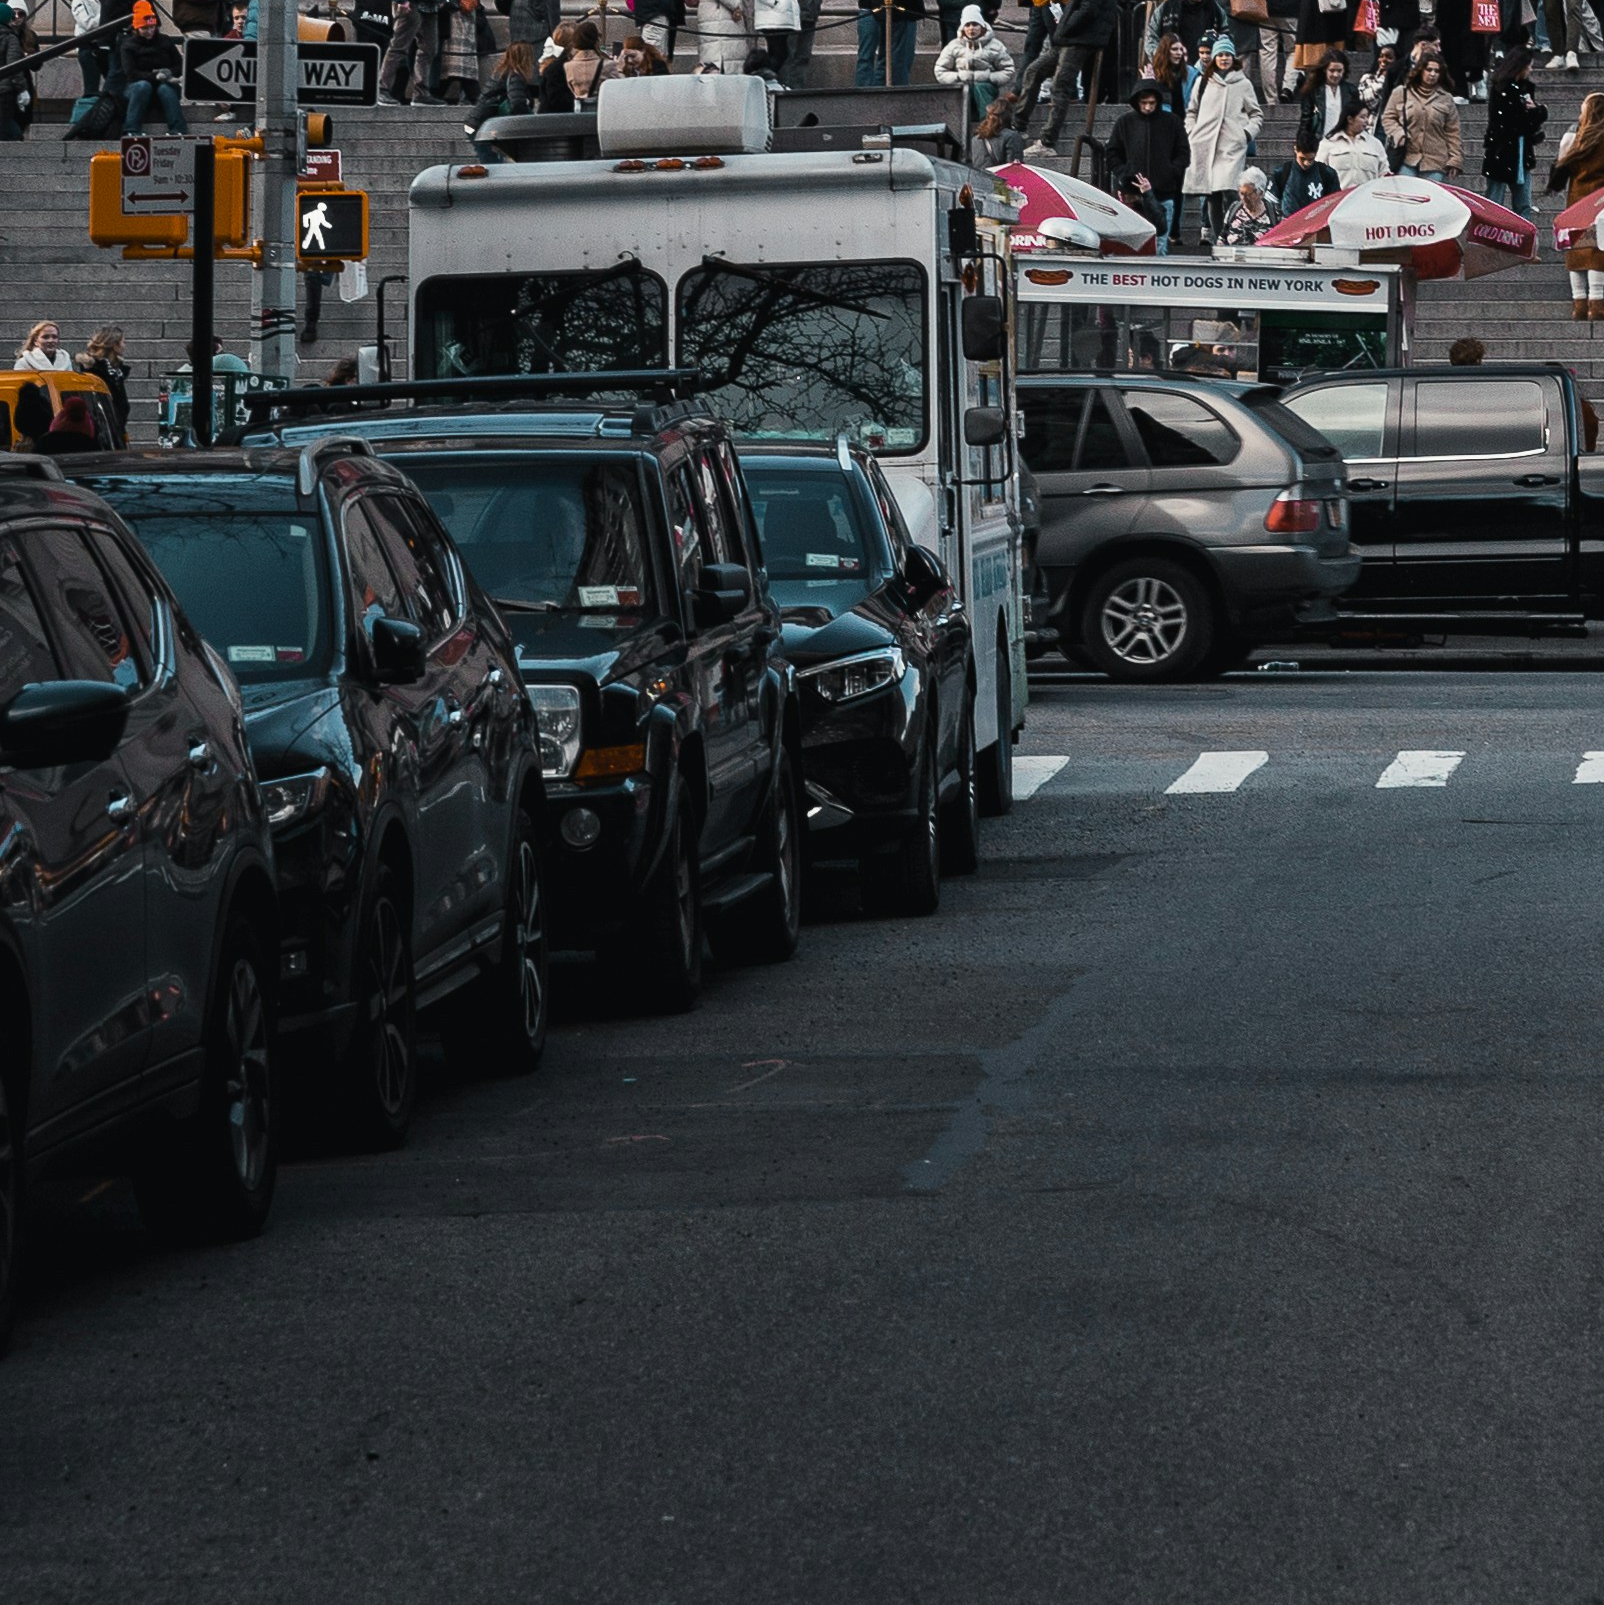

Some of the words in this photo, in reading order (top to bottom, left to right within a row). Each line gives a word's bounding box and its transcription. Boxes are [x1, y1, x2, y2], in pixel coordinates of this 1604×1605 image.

[216, 58, 257, 84] ON
[304, 62, 357, 87] WAY
[1366, 226, 1392, 240] HOT
[1397, 224, 1435, 238] DOGS
[1081, 273, 1108, 285] THE
[1112, 274, 1147, 286] BEST
[1151, 275, 1180, 288] HOT
[1184, 276, 1223, 289] DOGS
[1227, 278, 1244, 289] IN
[1248, 278, 1281, 291] NEW
[1285, 279, 1324, 292] YORK
